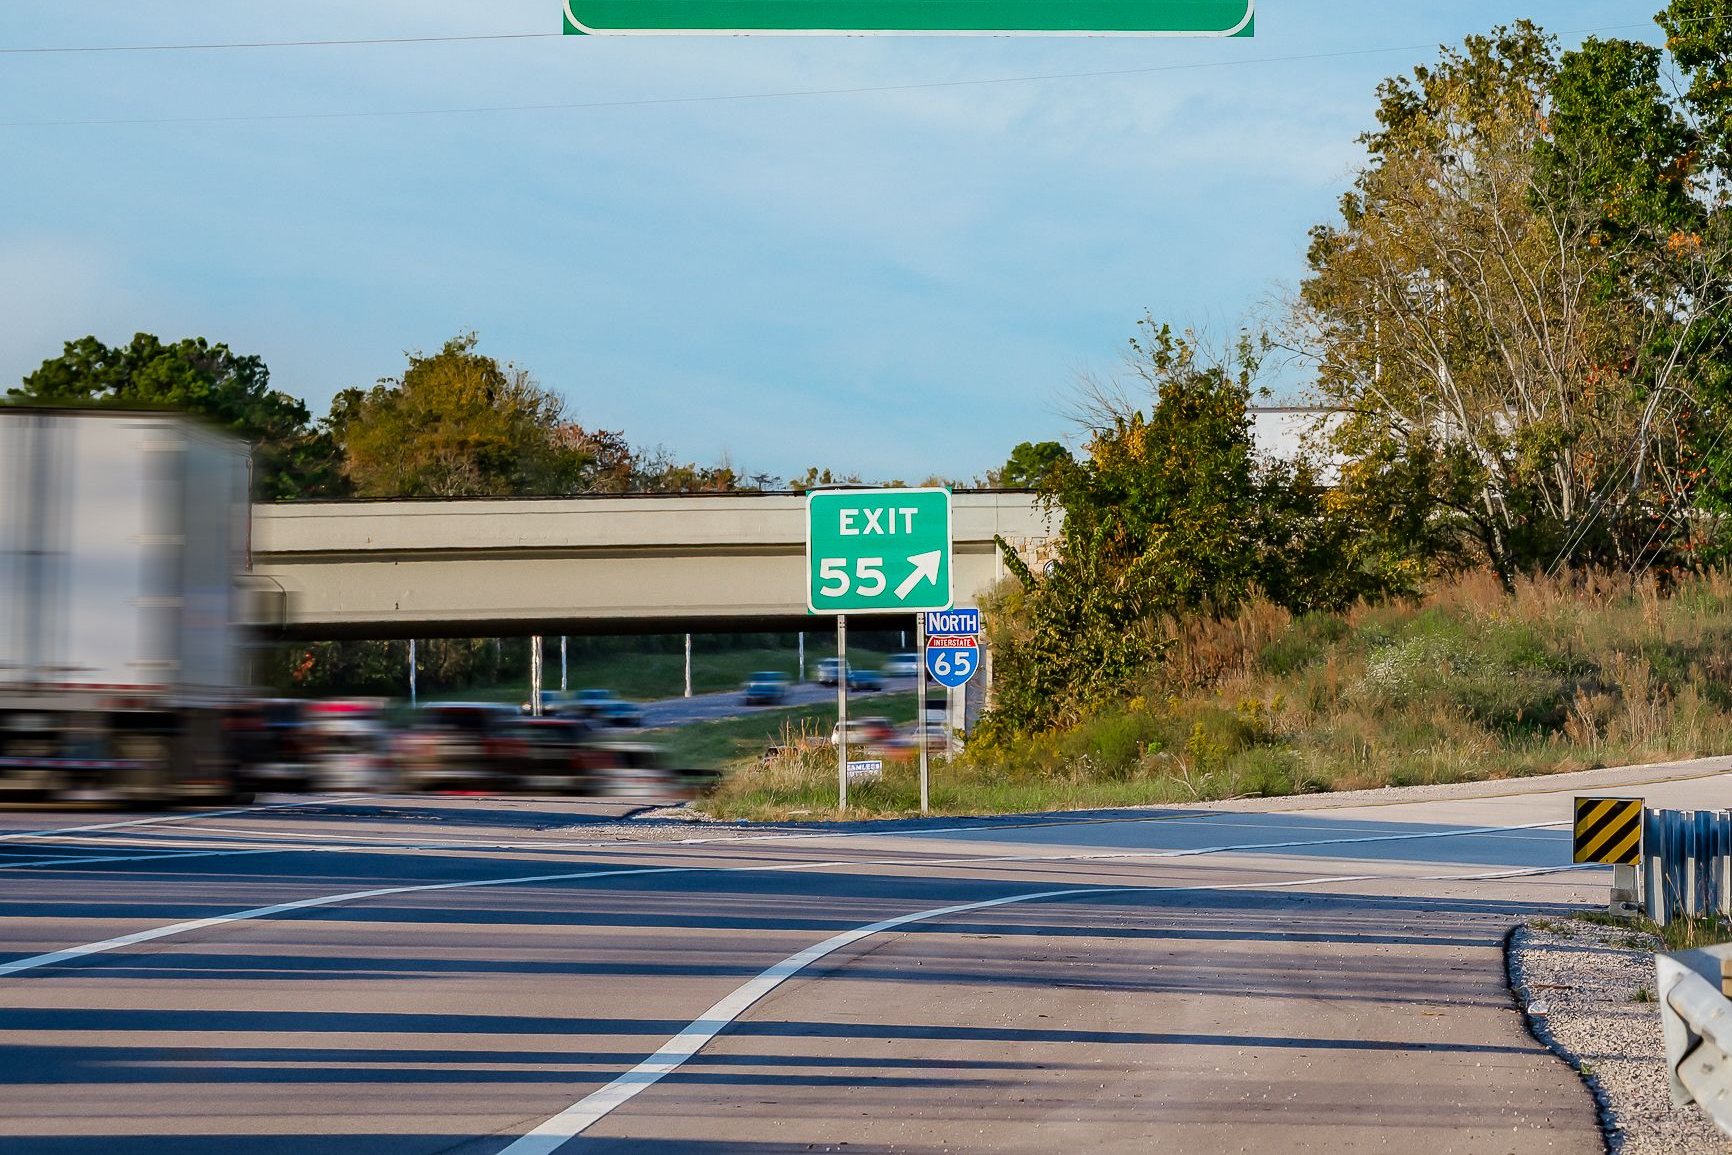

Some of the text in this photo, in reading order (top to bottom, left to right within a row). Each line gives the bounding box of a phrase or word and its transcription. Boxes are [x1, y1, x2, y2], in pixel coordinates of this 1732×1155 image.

[839, 507, 919, 536] EXIT
[819, 557, 887, 598] 55
[928, 612, 977, 632] NORTH
[933, 639, 972, 647] INTERSTATE
[934, 651, 971, 676] 65
[847, 763, 880, 771] EAMLESS
